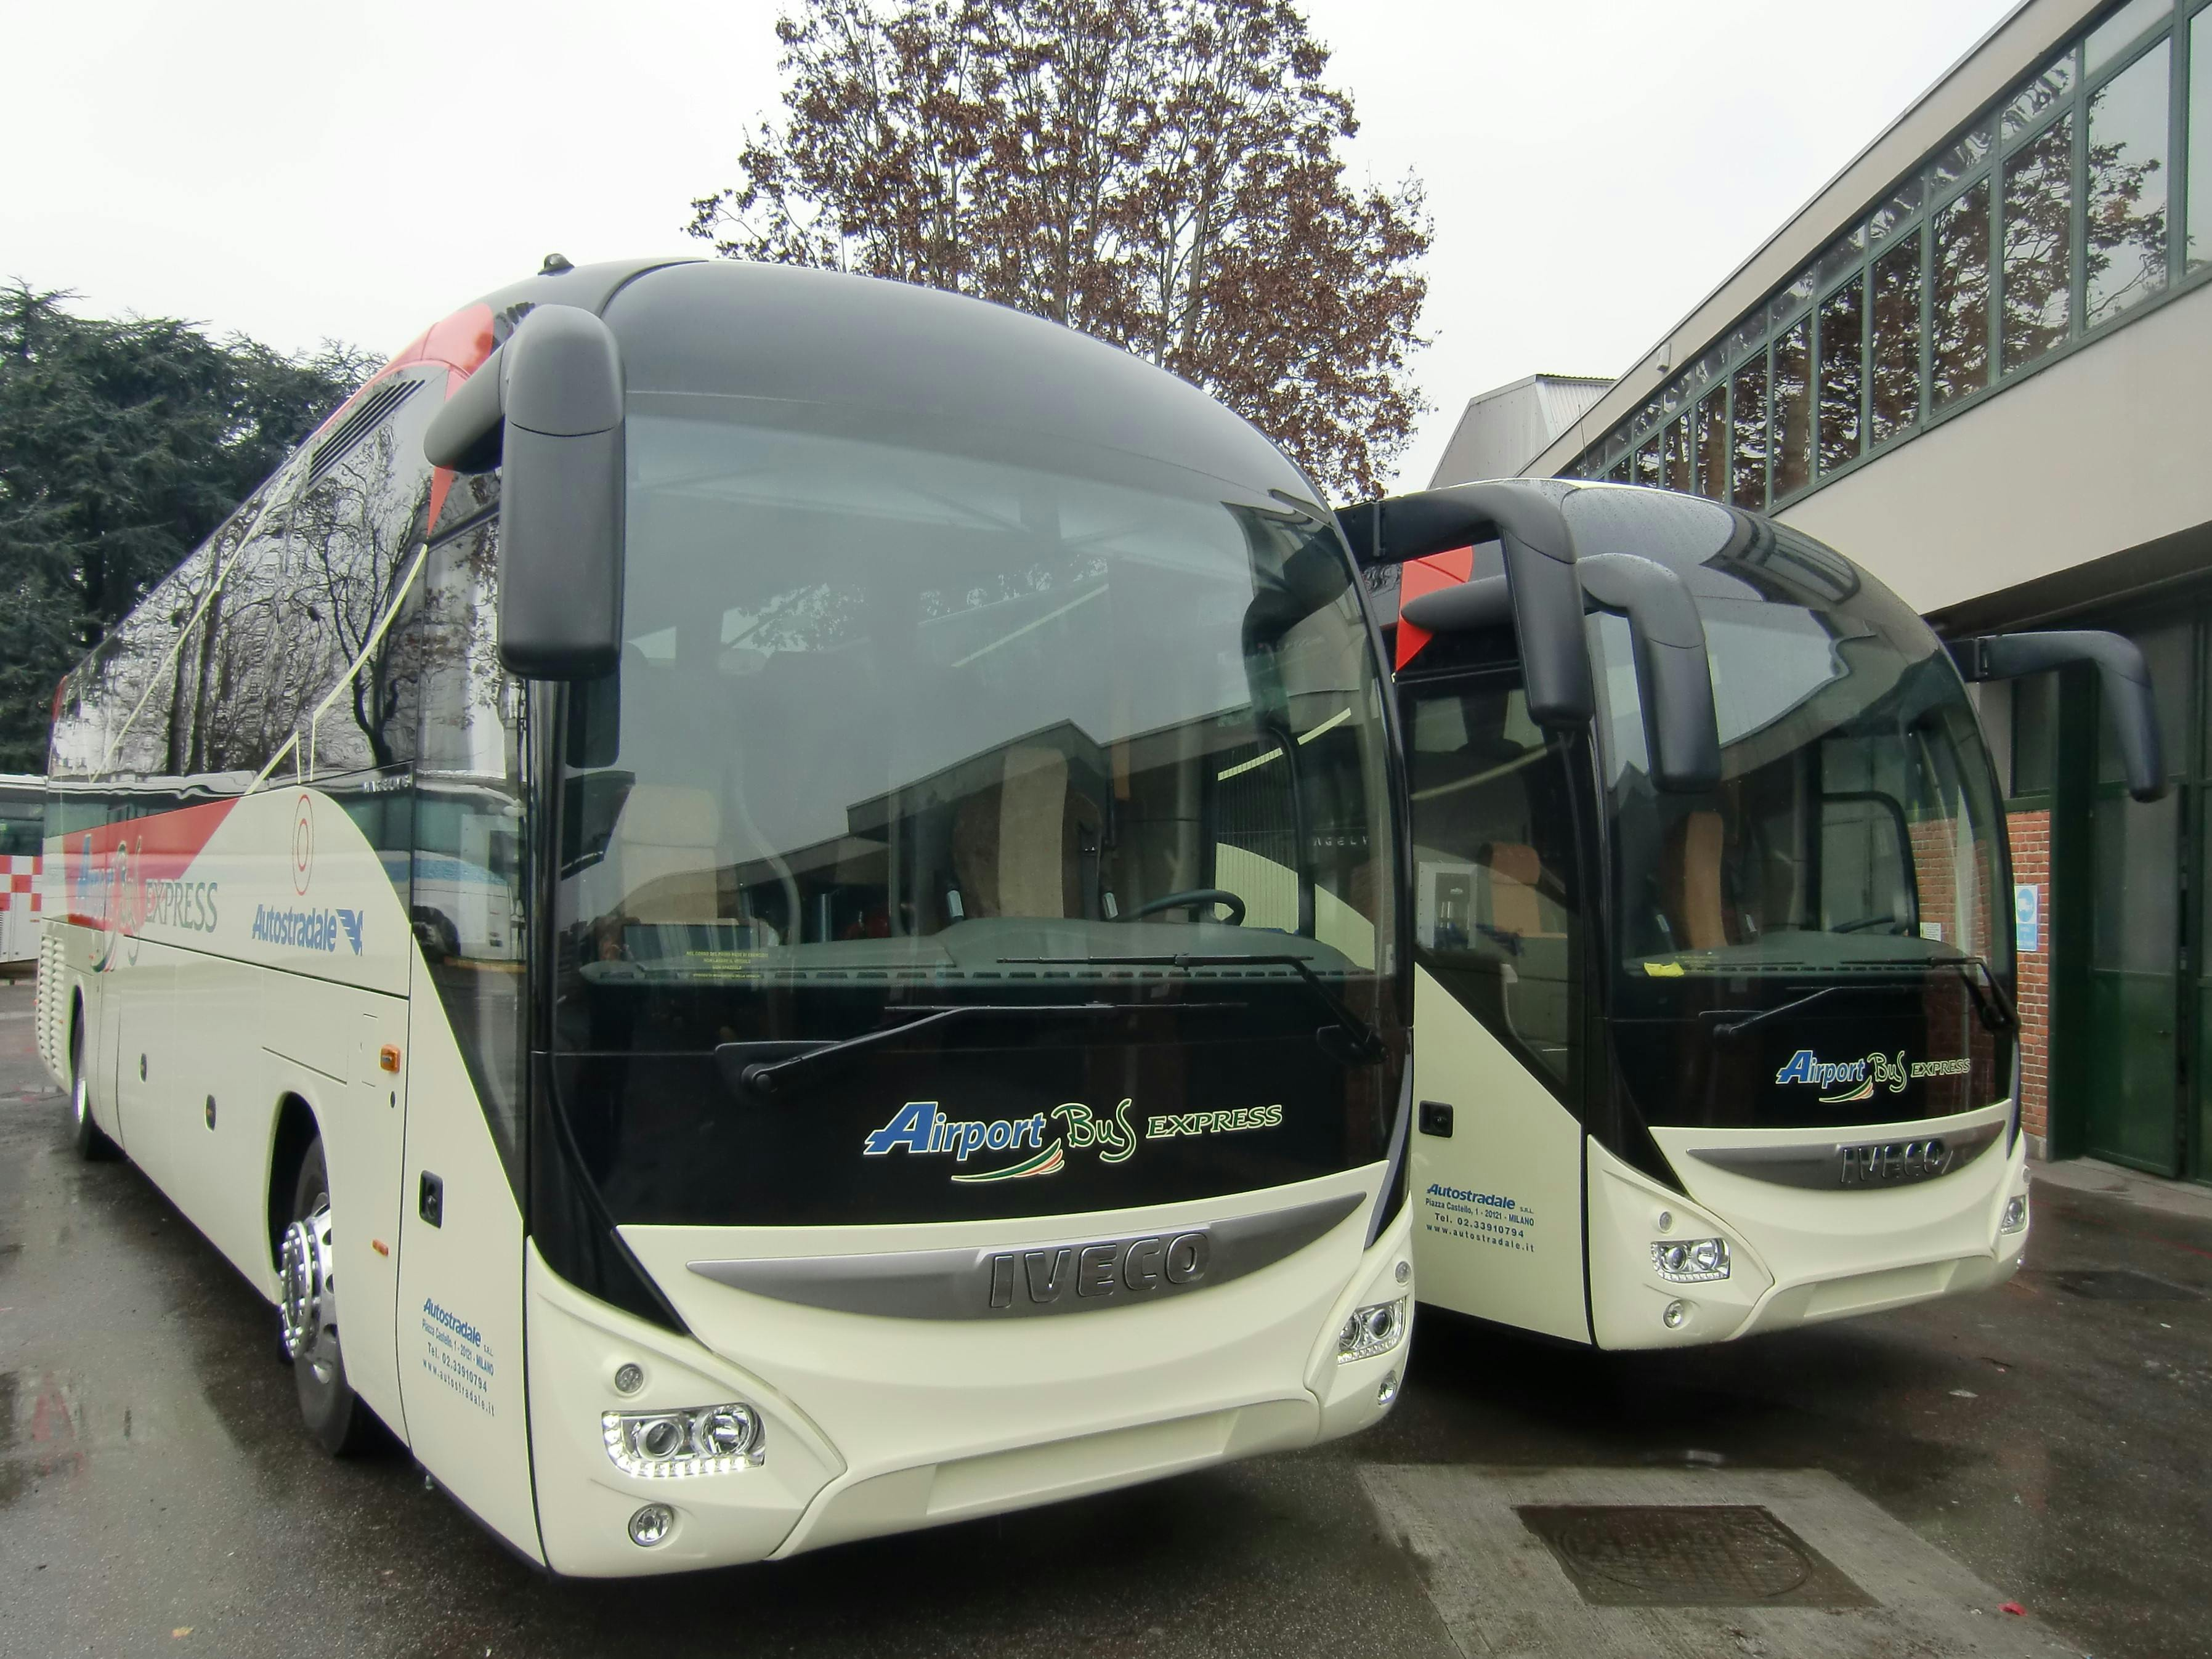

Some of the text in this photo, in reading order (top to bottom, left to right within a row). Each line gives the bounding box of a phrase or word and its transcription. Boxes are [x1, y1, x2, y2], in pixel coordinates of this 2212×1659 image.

[145, 878, 218, 933] EXPRESS
[251, 904, 338, 952] Autostradale
[1775, 1050, 1865, 1089] Airport
[1911, 1058, 1971, 1078] EXPRESS
[863, 1100, 1047, 1162] Airport
[1145, 1104, 1282, 1140] EXPRESS
[1840, 1140, 1945, 1183] IVECO
[1425, 1198, 1445, 1209] Piazza
[1485, 1209, 1502, 1220] 20121
[1509, 1214, 1534, 1227] MILANO
[1426, 1183, 1516, 1210] Autostradale
[1425, 1223, 1535, 1252] www.autostradale.it
[1435, 1212, 1525, 1238] Tel. 02.33910794
[989, 1231, 1211, 1309] IVECO
[423, 1297, 482, 1347] Autostradale
[423, 1358, 495, 1417] www.autostradale.it
[427, 1342, 487, 1393] Tel. 02.33910794
